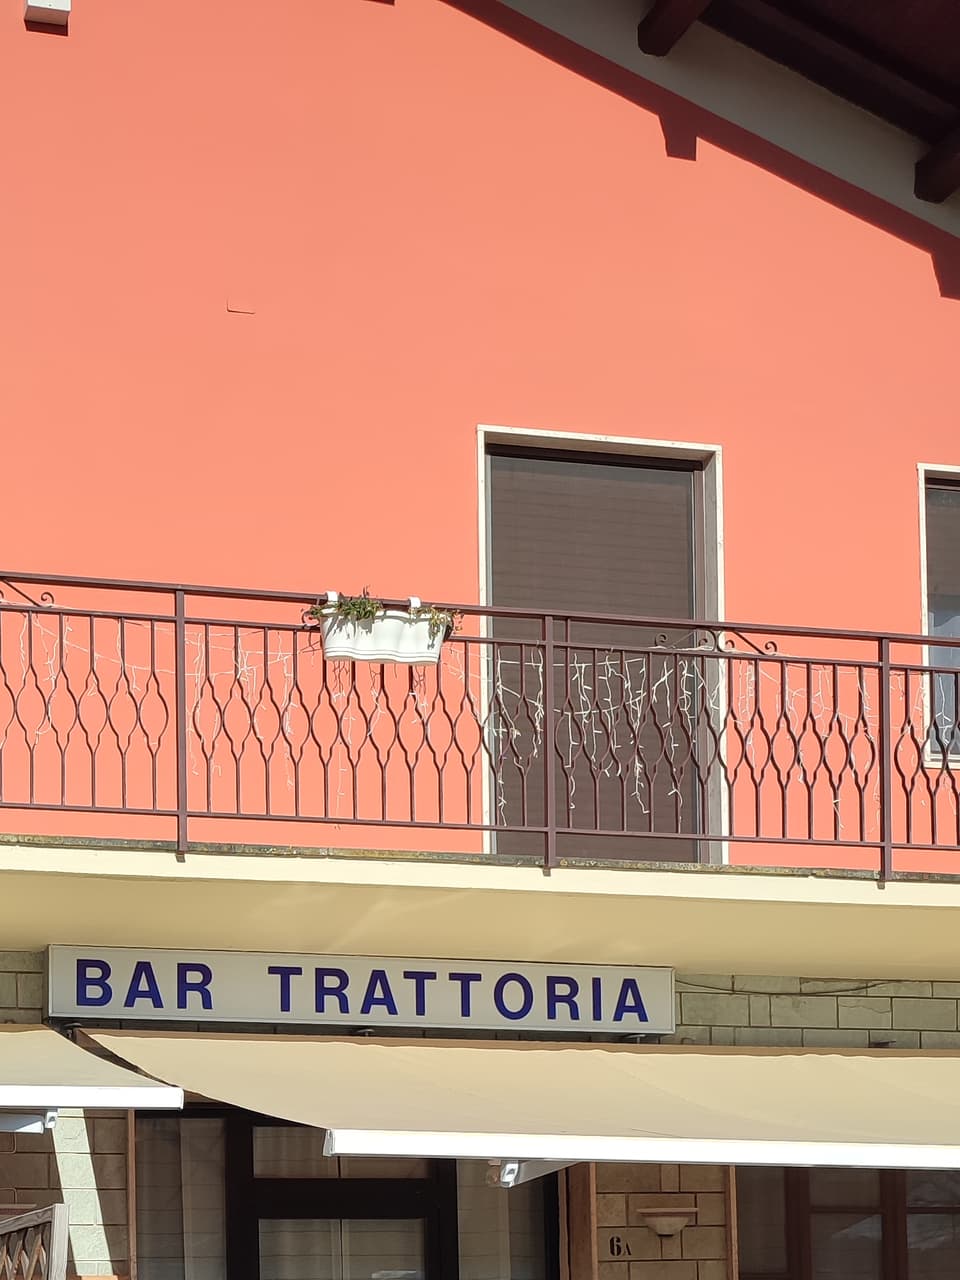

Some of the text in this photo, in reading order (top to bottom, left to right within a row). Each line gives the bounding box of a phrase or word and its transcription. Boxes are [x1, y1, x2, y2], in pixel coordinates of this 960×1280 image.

[76, 959, 648, 1022] BAR TRATTORIA
[609, 1236, 632, 1256] 6A
